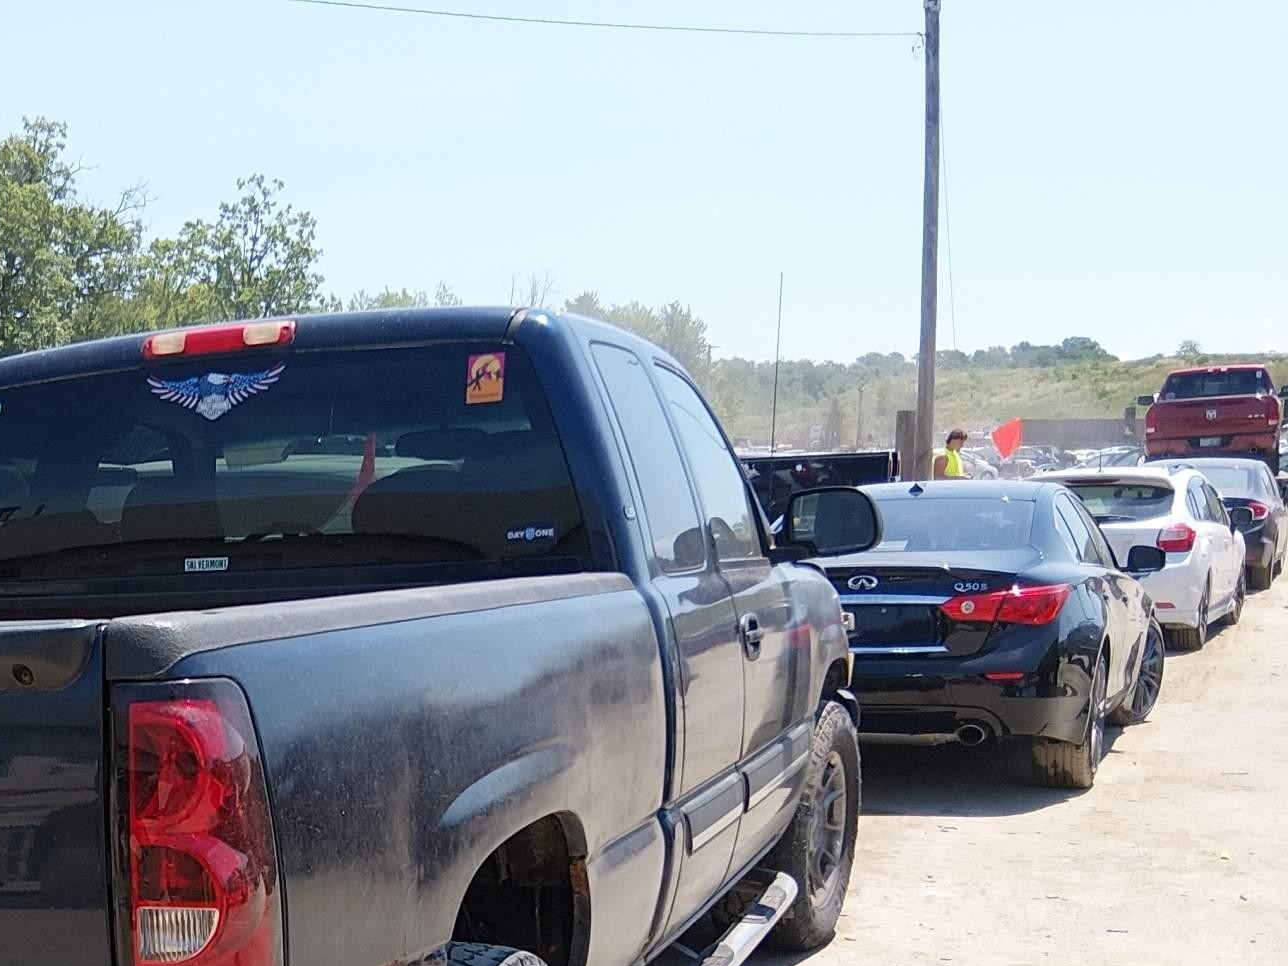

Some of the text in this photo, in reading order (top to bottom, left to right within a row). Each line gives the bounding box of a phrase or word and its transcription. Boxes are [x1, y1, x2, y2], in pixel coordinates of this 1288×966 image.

[507, 528, 554, 540] DAY ONE
[198, 559, 227, 569] VERMONT
